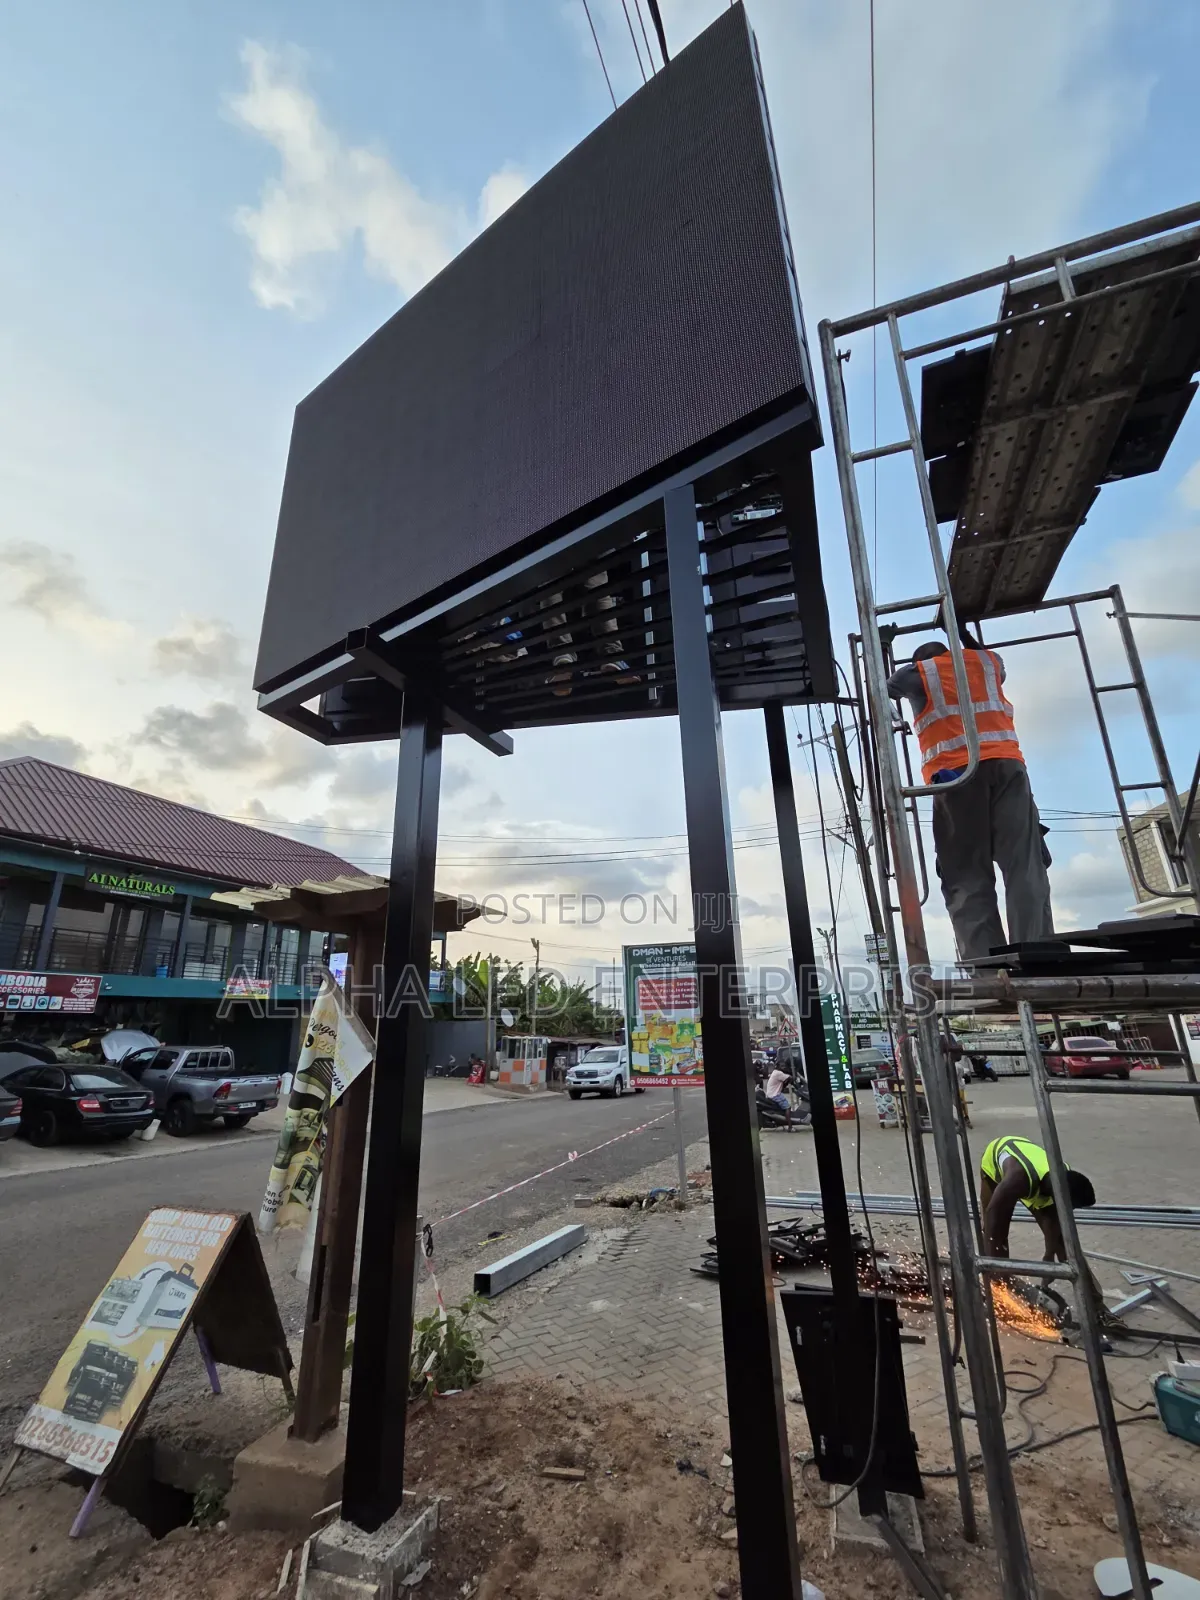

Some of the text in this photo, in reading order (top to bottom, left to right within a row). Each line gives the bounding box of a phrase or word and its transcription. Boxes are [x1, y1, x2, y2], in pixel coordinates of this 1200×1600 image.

[108, 874, 176, 896] NATURALS
[654, 955, 687, 963] VENTURES
[831, 993, 846, 1054] PHARMACY
[841, 1055, 848, 1063] &
[842, 1064, 853, 1089] LAB
[180, 1212, 210, 1229] YOUR
[207, 1215, 233, 1232] OLD
[197, 1230, 221, 1247] FOR
[144, 1240, 201, 1261] NEW ONES
